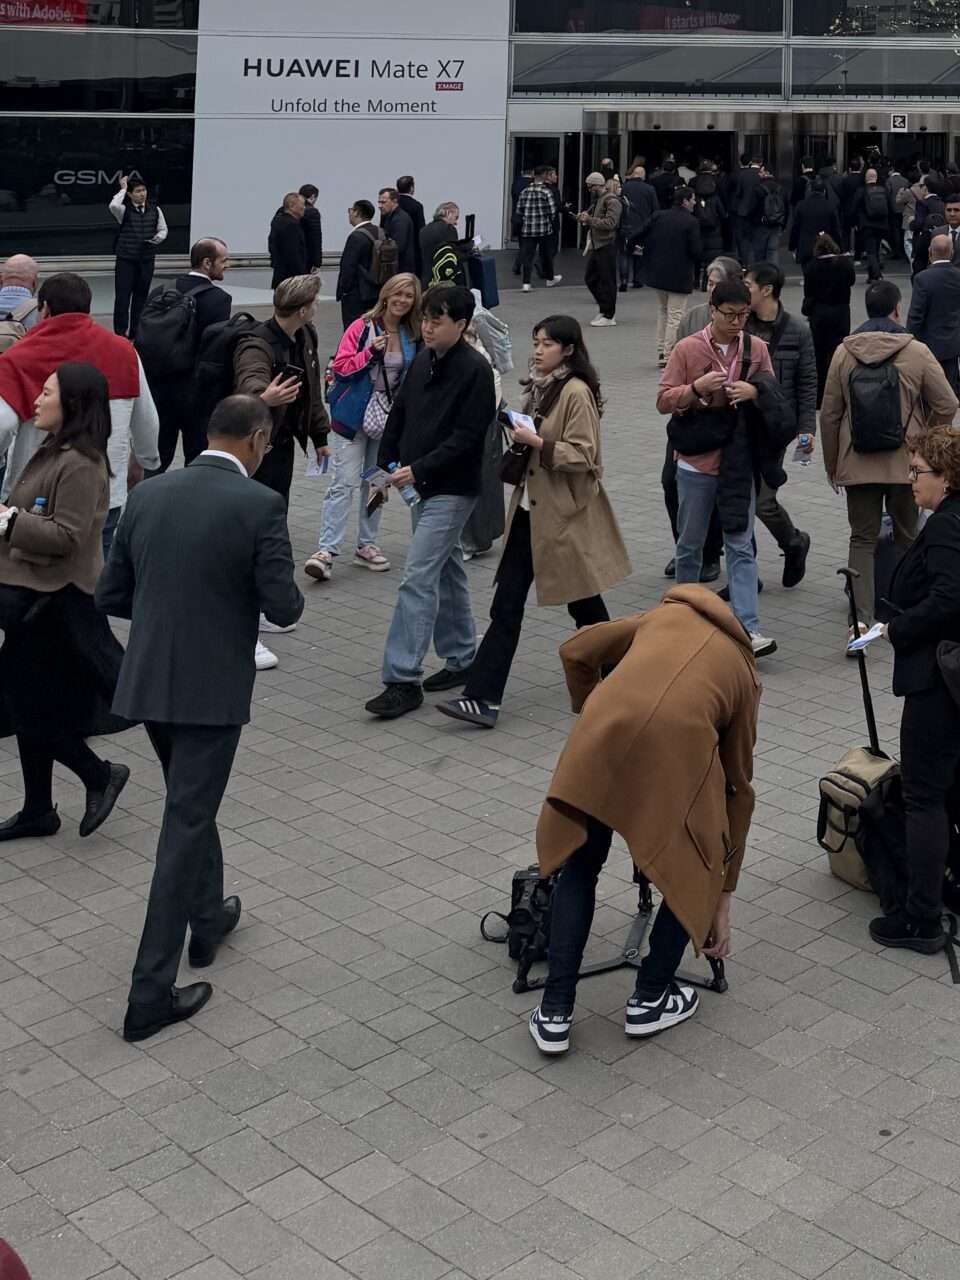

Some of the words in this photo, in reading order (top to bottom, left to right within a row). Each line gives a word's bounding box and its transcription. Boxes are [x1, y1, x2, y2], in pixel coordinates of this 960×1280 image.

[6, 1, 30, 18] with
[243, 58, 360, 78] HUAWEI
[371, 59, 428, 79] Mate
[436, 59, 464, 79] X7
[271, 98, 327, 113] Unfold
[334, 98, 361, 113] the
[367, 99, 437, 113] Moment
[53, 170, 143, 185] GSMA
